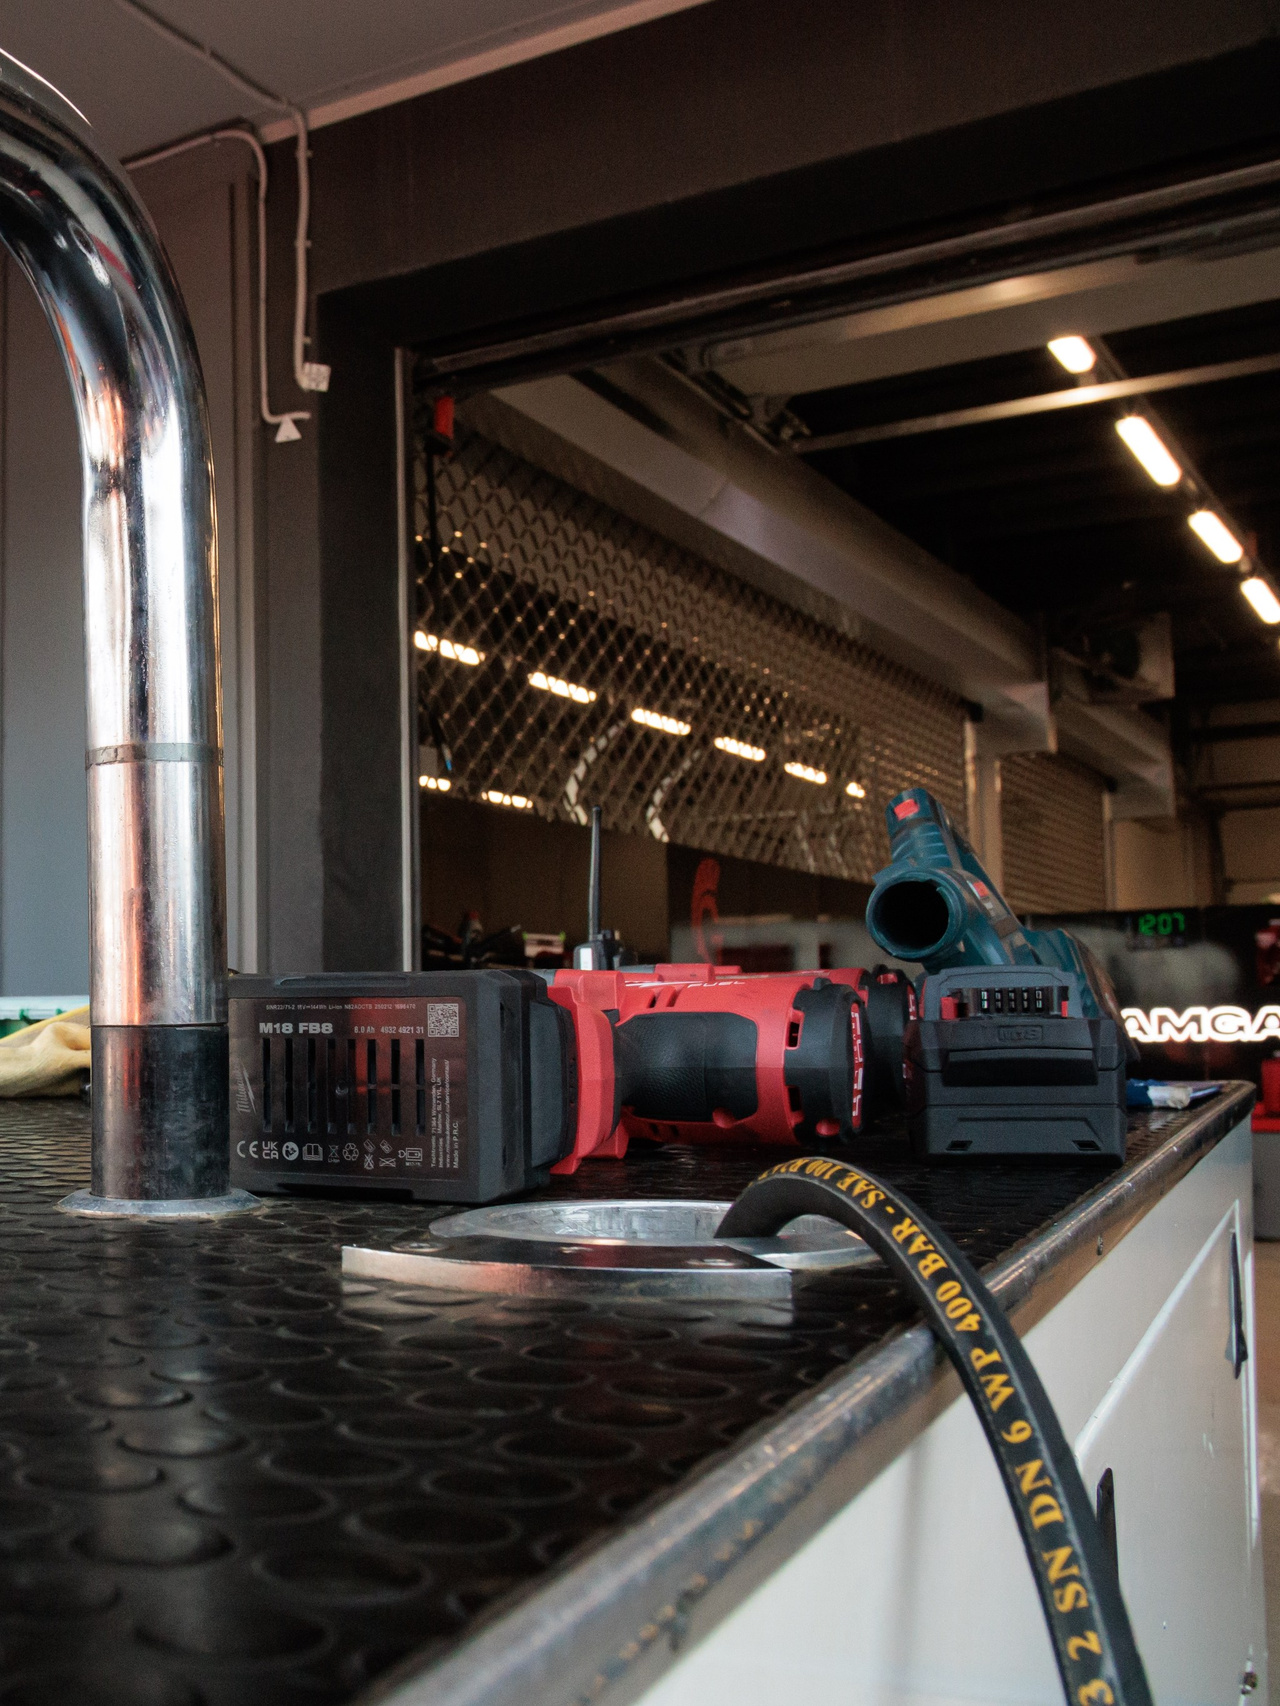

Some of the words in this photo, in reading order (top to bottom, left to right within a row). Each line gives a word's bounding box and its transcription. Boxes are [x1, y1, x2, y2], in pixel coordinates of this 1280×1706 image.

[259, 1022, 293, 1034] M18
[298, 1022, 334, 1034] FB8
[366, 1026, 376, 1034] Ah
[381, 1026, 397, 1034] 4932
[398, 1026, 414, 1034] 4921
[416, 1026, 424, 1034] 31
[805, 1160, 844, 1180] 100
[836, 1172, 886, 1209] SAE
[891, 1217, 948, 1280] BAR
[935, 1280, 982, 1332] 400
[969, 1347, 1015, 1413] WP
[1001, 1420, 1033, 1444] 6
[1014, 1459, 1065, 1532] DN
[1041, 1545, 1090, 1613] SN
[1066, 1629, 1103, 1661] 2
